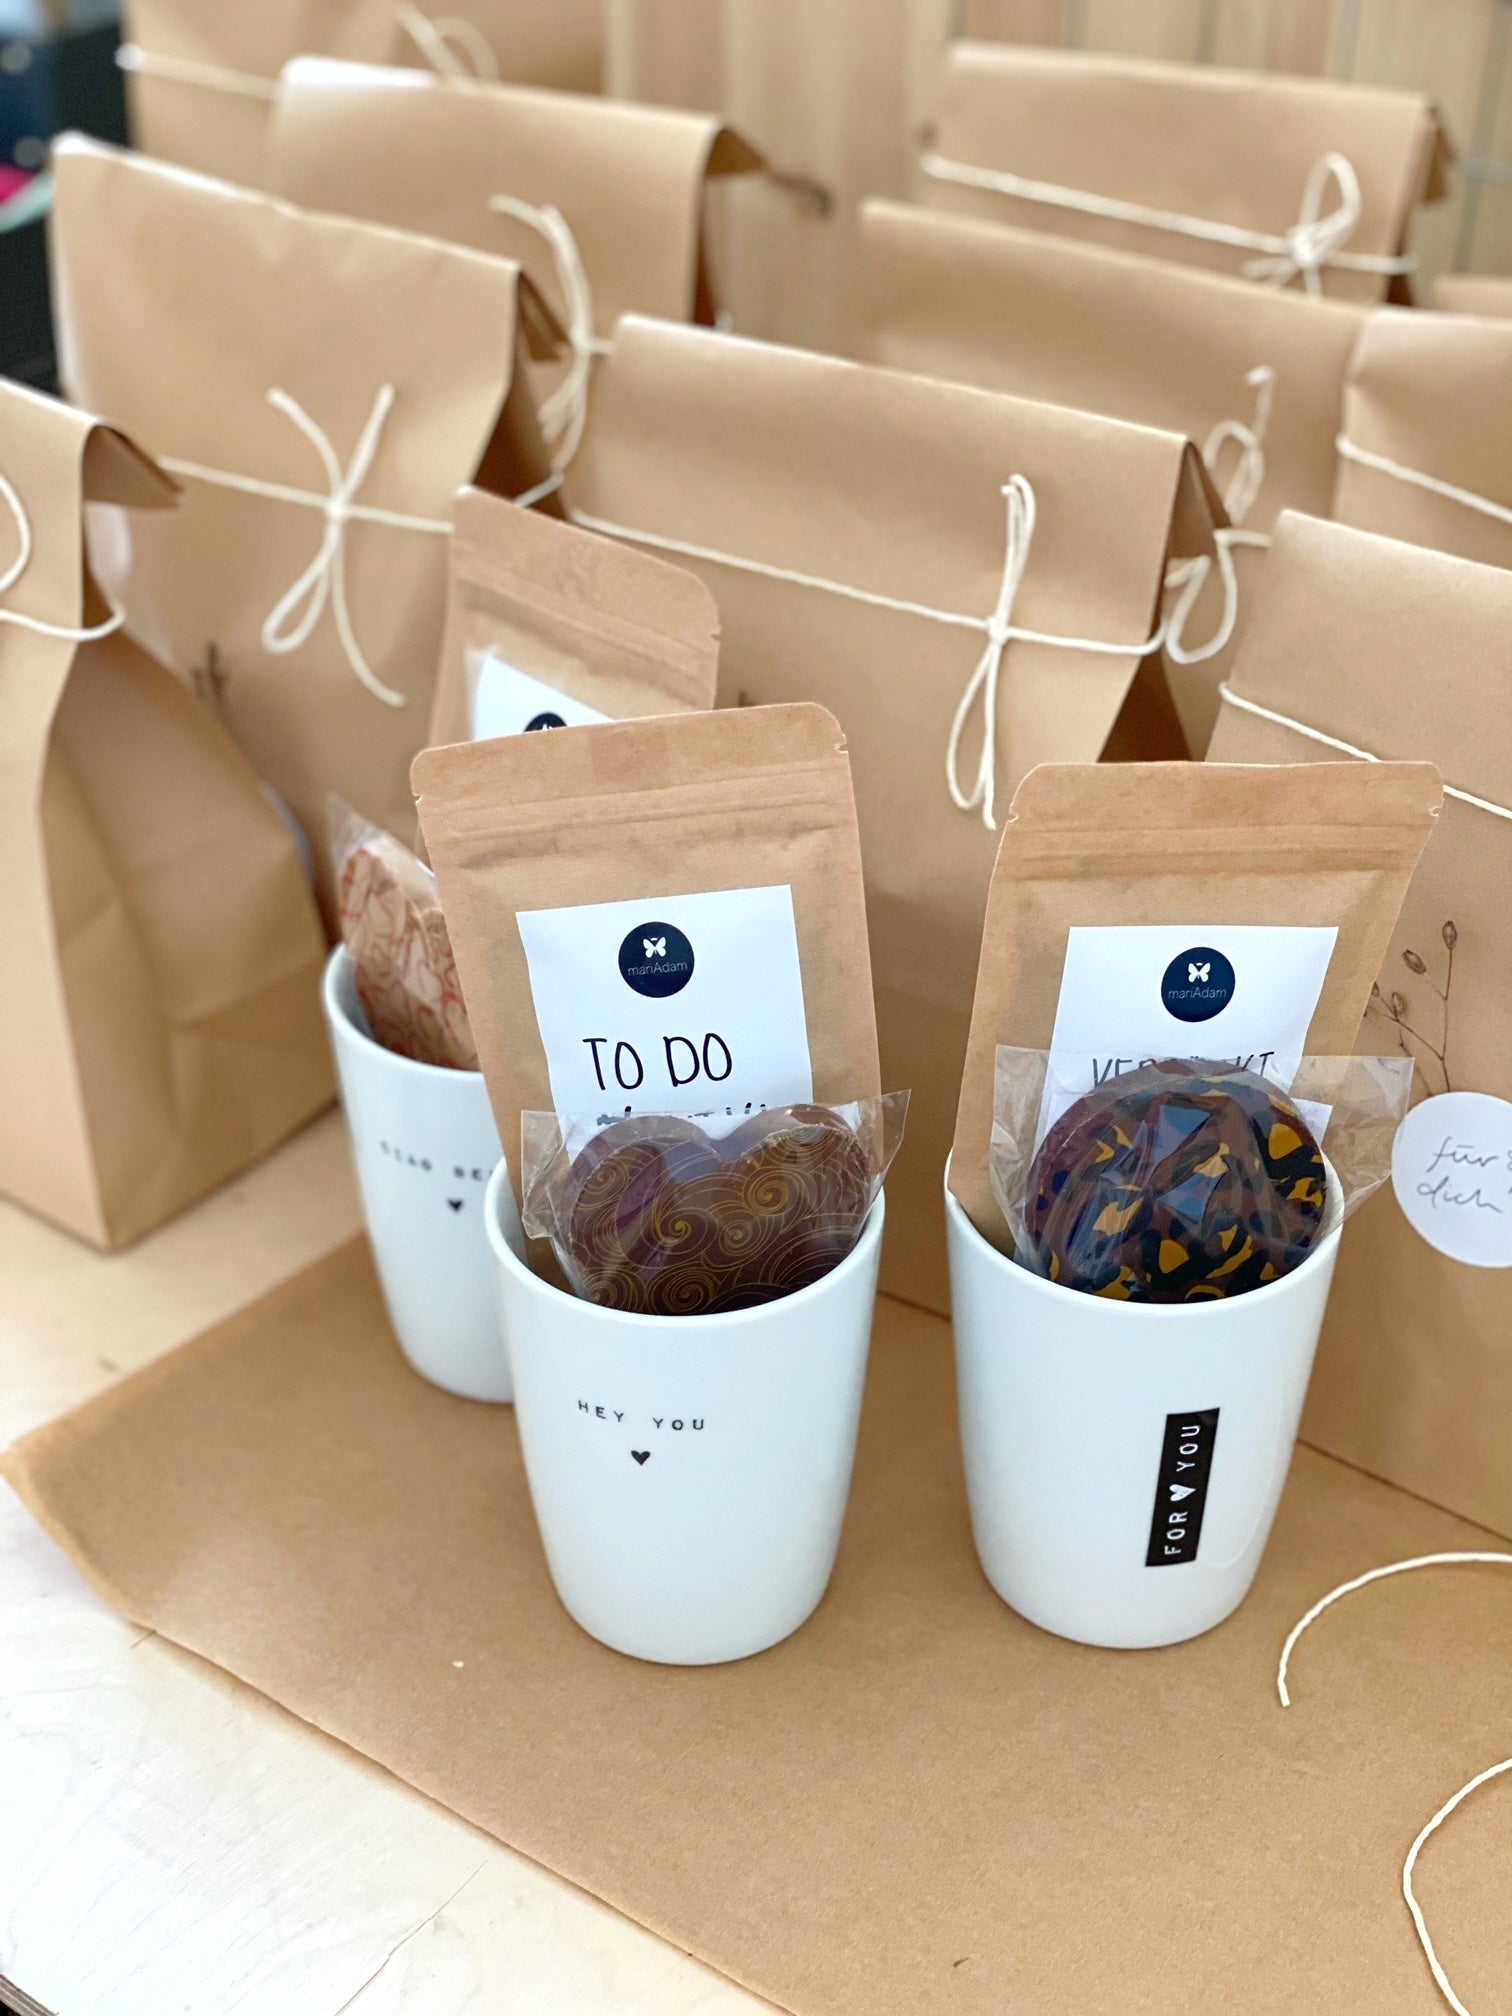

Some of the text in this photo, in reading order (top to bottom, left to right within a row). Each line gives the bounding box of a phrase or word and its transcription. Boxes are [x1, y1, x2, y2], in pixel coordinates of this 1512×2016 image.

[627, 960, 688, 976] mariAdam
[1167, 986, 1228, 1000] mariAdam
[582, 1032, 733, 1091] TO DO
[577, 1399, 705, 1432] HEY YOU
[1163, 1424, 1201, 1556] FOR YOU
